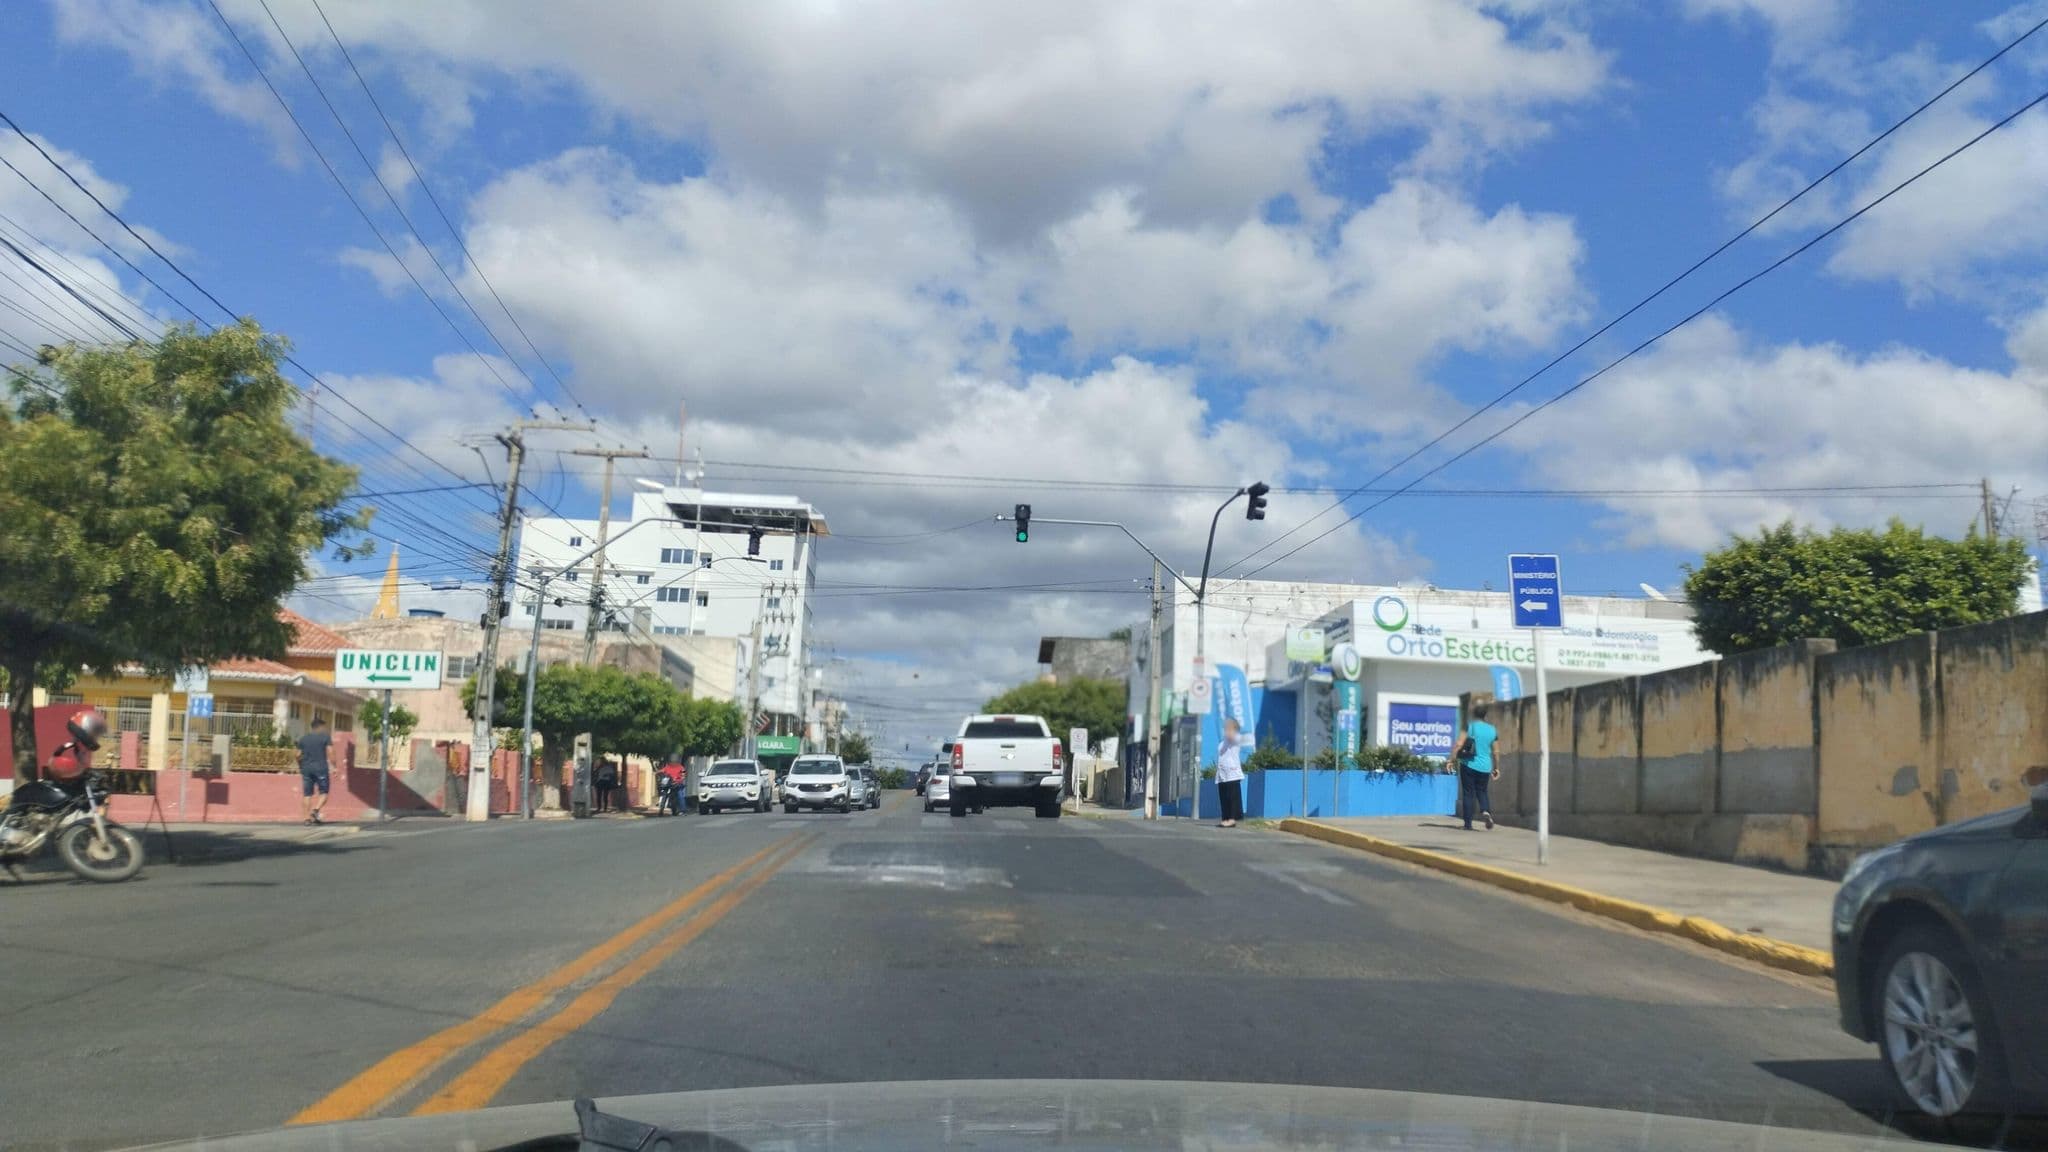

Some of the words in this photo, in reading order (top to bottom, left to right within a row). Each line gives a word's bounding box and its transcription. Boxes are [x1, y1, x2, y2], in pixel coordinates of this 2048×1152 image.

[1520, 586, 1554, 595] PÚBLICO
[1411, 623, 1442, 637] Rede
[342, 653, 437, 671] UNICLIN
[1392, 719, 1414, 732] Seu
[1415, 721, 1452, 734] sorriso
[762, 741, 785, 749] CLARA
[1391, 730, 1452, 750] importa
